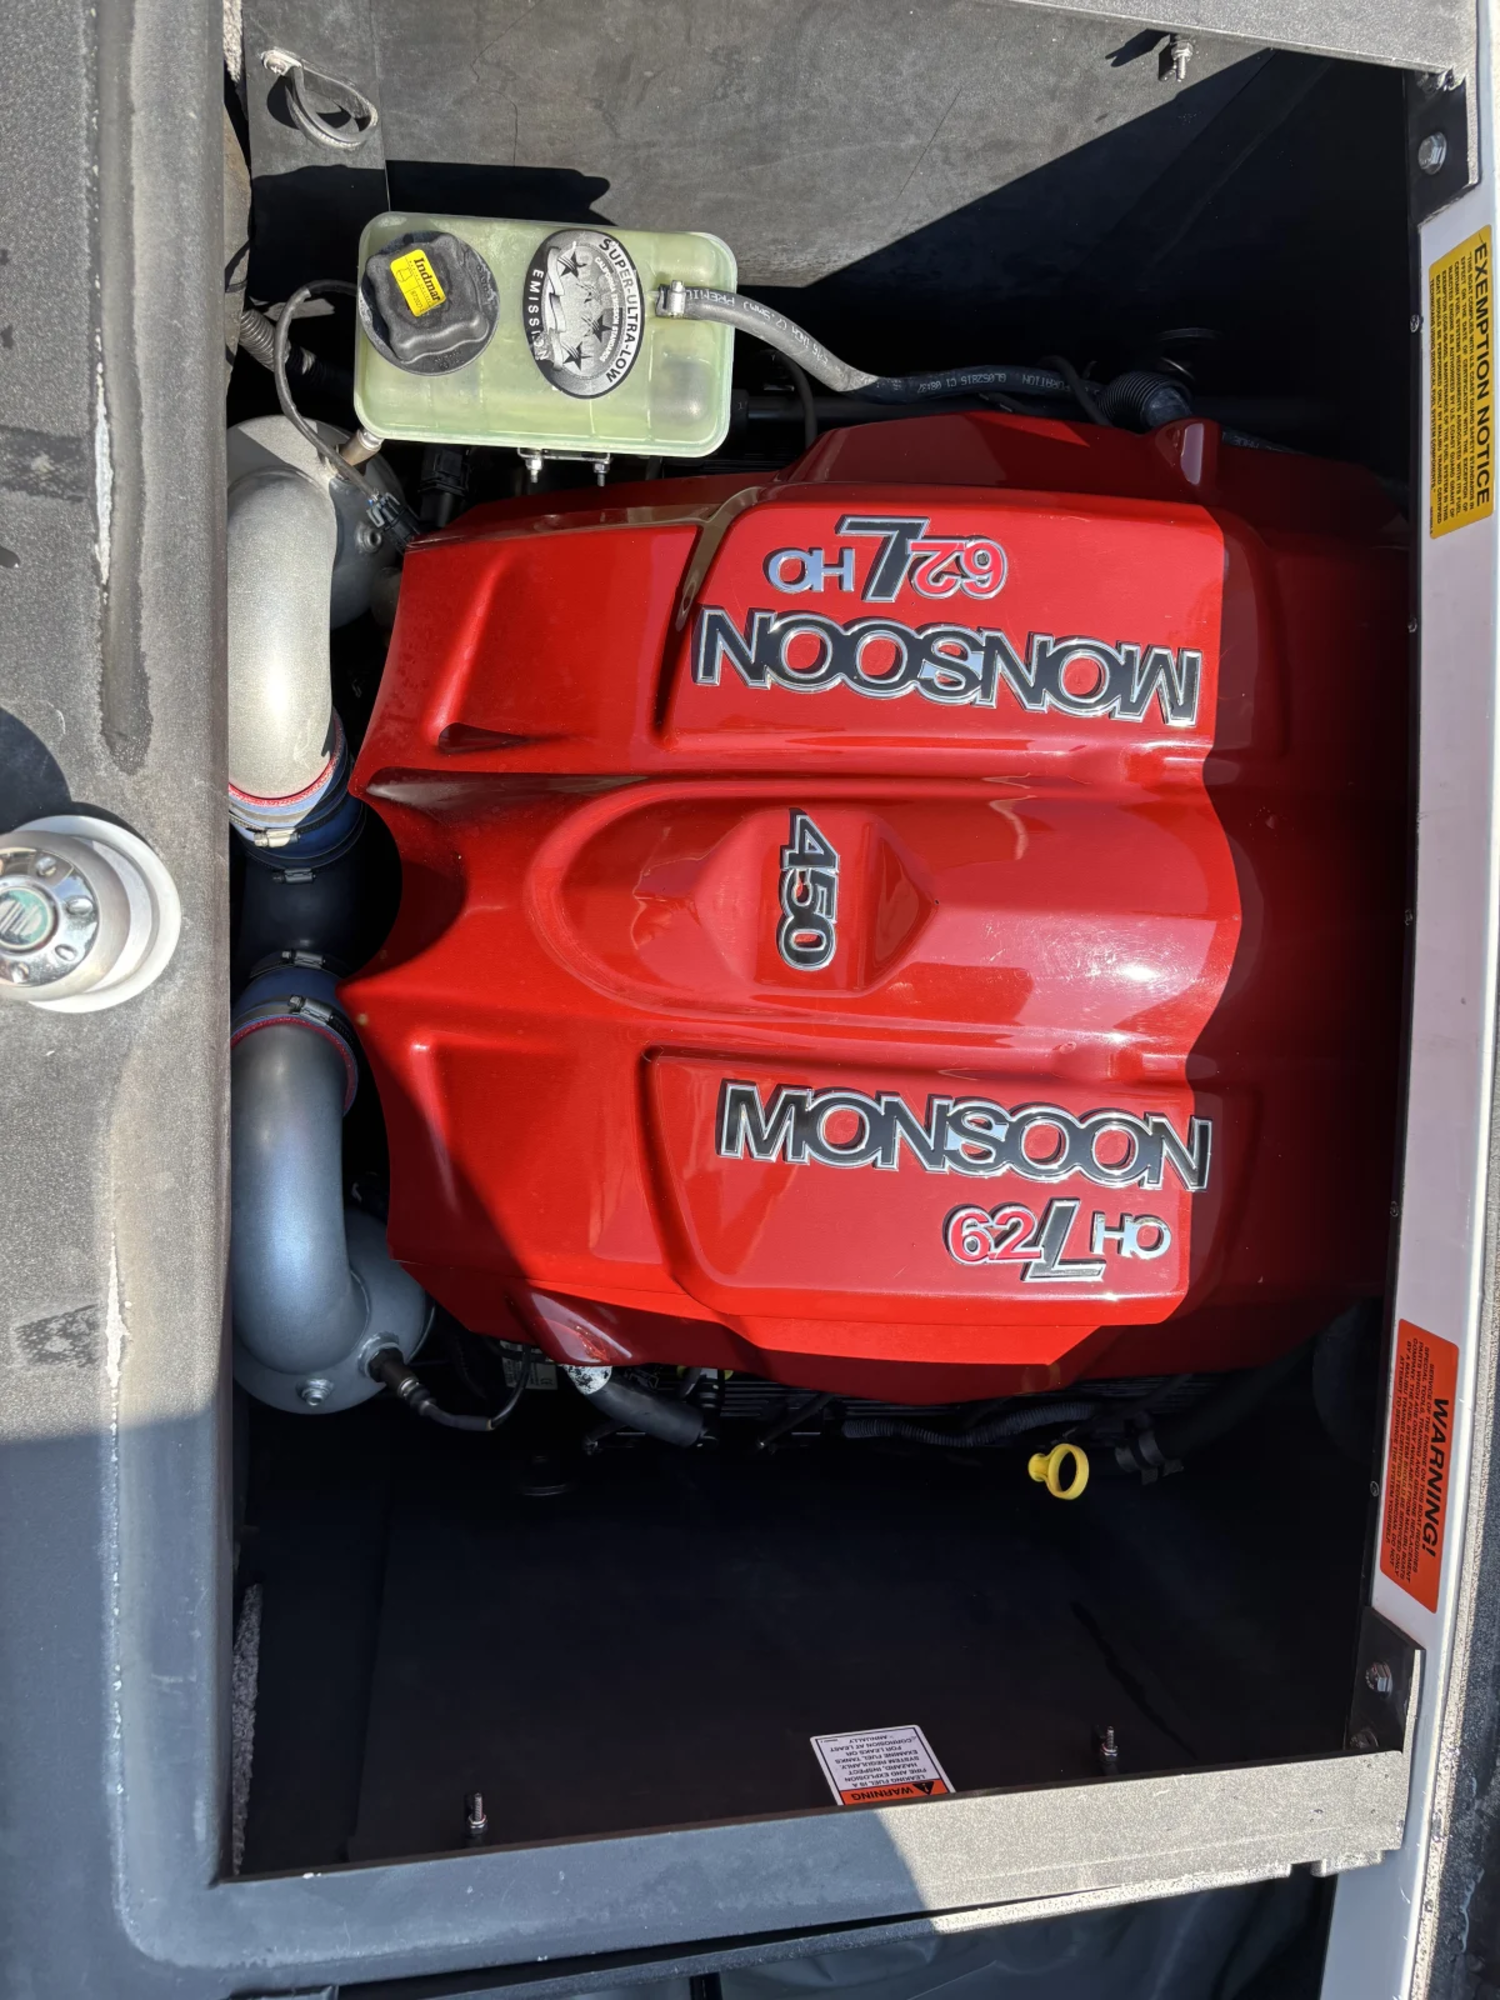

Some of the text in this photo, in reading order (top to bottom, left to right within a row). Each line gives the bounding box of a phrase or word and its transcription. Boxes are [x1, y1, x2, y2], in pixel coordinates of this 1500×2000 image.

[414, 257, 442, 302] Indmar
[598, 237, 638, 383] SUPER-ULTRA-LOW
[598, 325, 618, 362] STANDARDS
[1023, 374, 1071, 392] PORATION
[1475, 241, 1489, 506] EXEMPTION NOTICE
[765, 548, 855, 594] HO
[694, 605, 1203, 728] MONSOON
[778, 811, 839, 972] 450
[717, 1080, 1214, 1192] MONSOON
[1090, 1211, 1173, 1260] HO
[1422, 1398, 1449, 1557] WARNING!
[828, 1744, 854, 1752] LEAST
[865, 1738, 912, 1747] CORROSION
[887, 1755, 919, 1763] SYSTEM
[843, 1772, 889, 1782] EXPLOSION
[850, 1786, 913, 1801] WARNING
[890, 1774, 925, 1782] LEAKING
